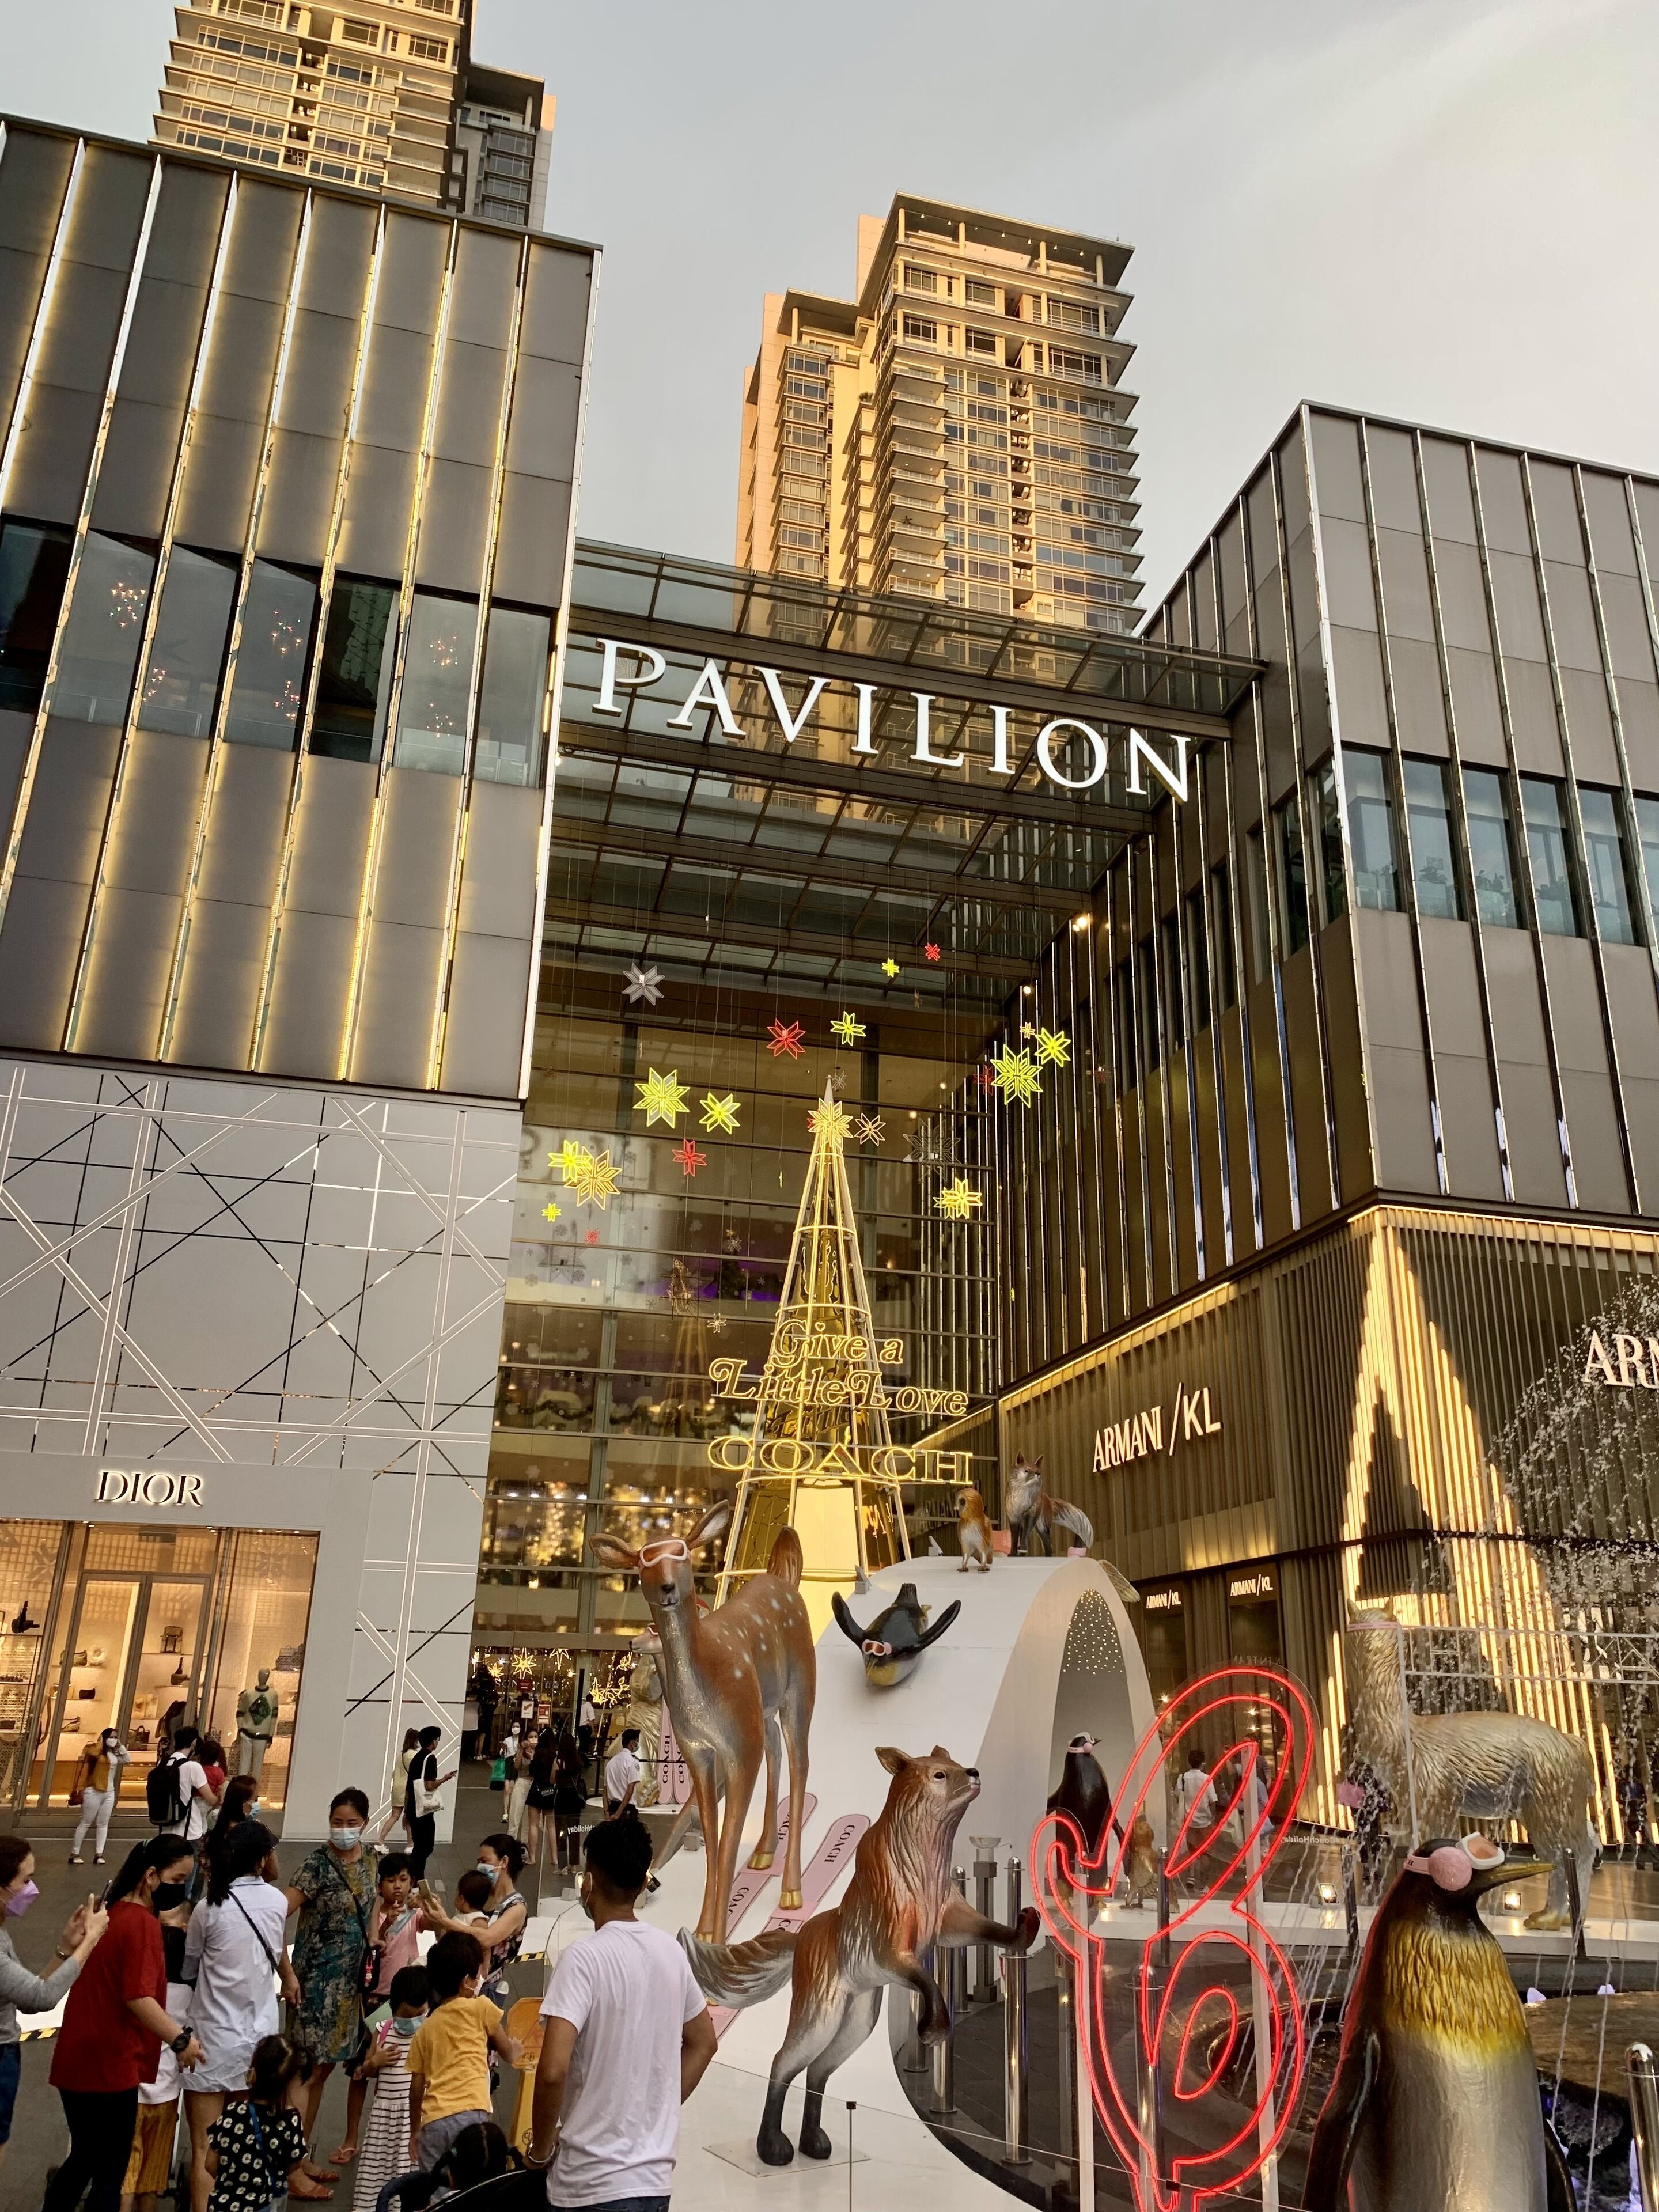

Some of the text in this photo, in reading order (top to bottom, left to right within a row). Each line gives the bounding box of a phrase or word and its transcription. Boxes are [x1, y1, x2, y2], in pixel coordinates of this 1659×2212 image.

[591, 637, 1192, 805] PAVILION
[770, 1318, 904, 1369] Give a
[708, 1357, 969, 1416] Little Love
[707, 1435, 974, 1486] COACH
[94, 1470, 203, 1508] DIOR
[676, 1741, 685, 1784] COAC
[824, 1824, 855, 1863] COACH
